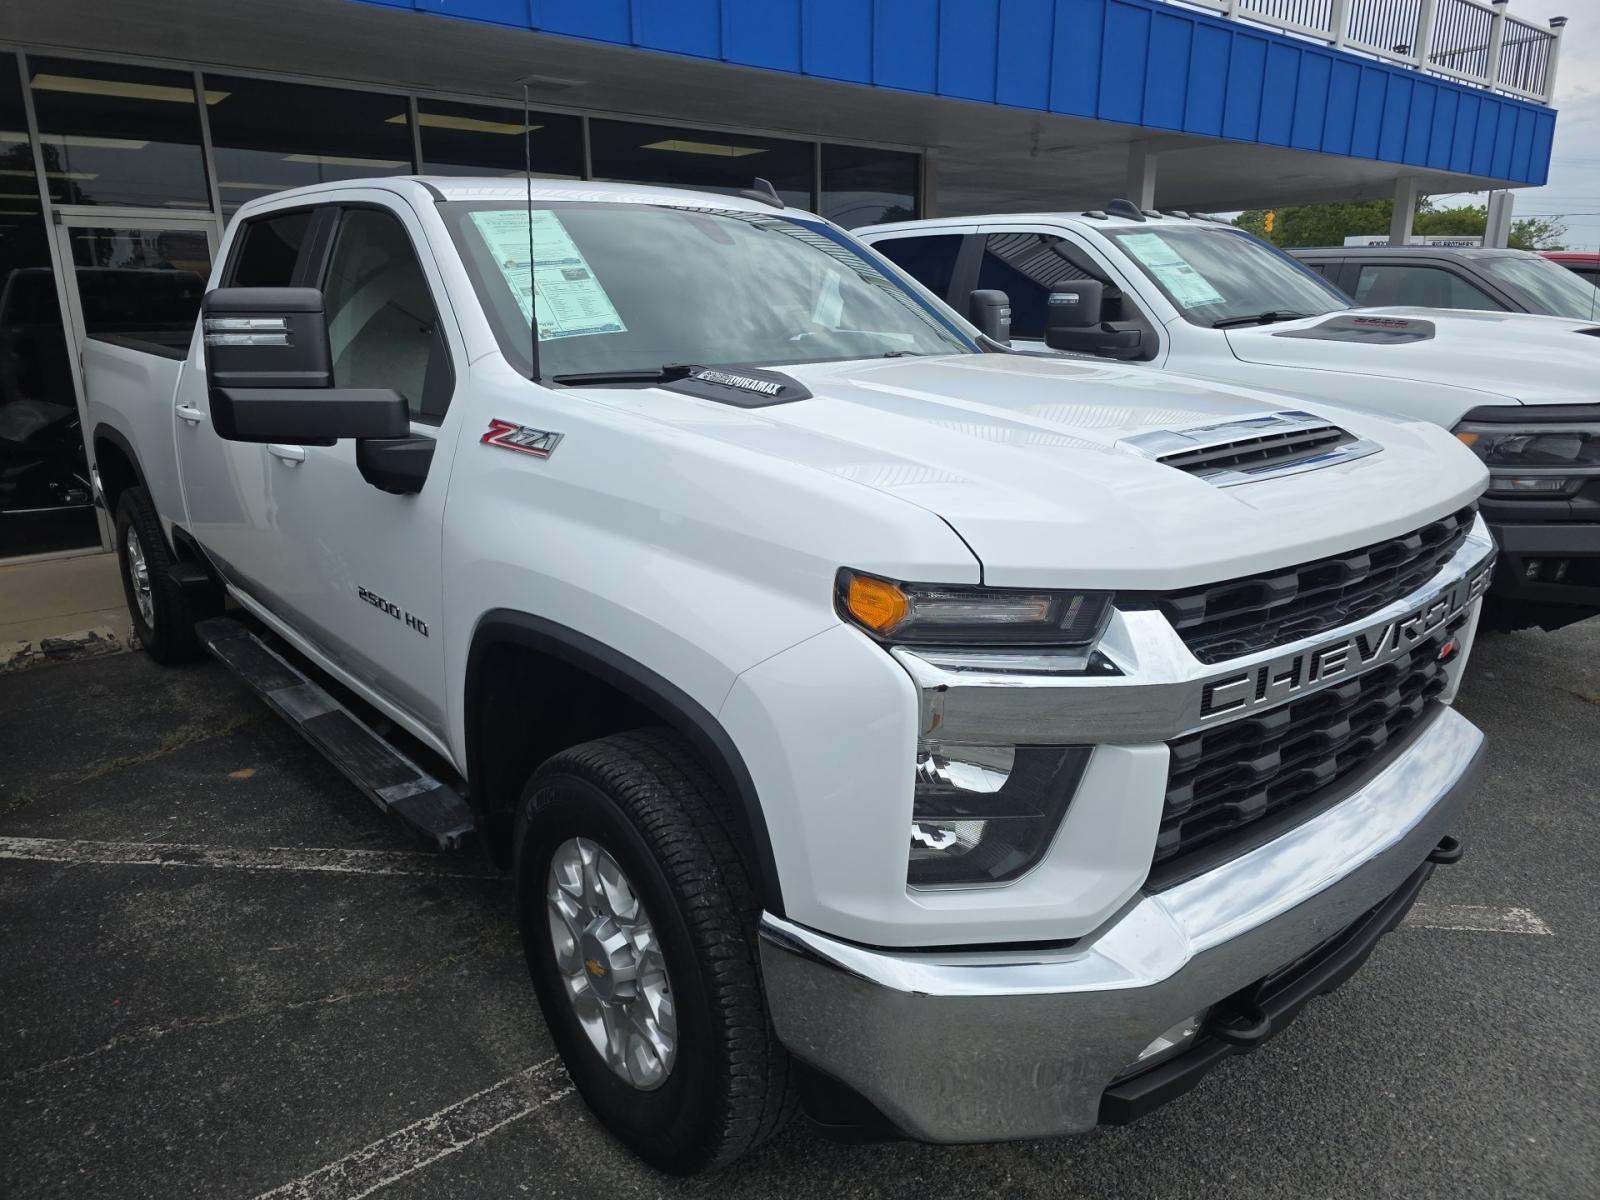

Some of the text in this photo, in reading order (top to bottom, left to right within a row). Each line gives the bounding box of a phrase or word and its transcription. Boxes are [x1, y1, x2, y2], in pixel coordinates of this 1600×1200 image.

[730, 375, 783, 395] DURAMAX
[480, 418, 565, 460] Z71
[358, 585, 429, 638] 2500 HD
